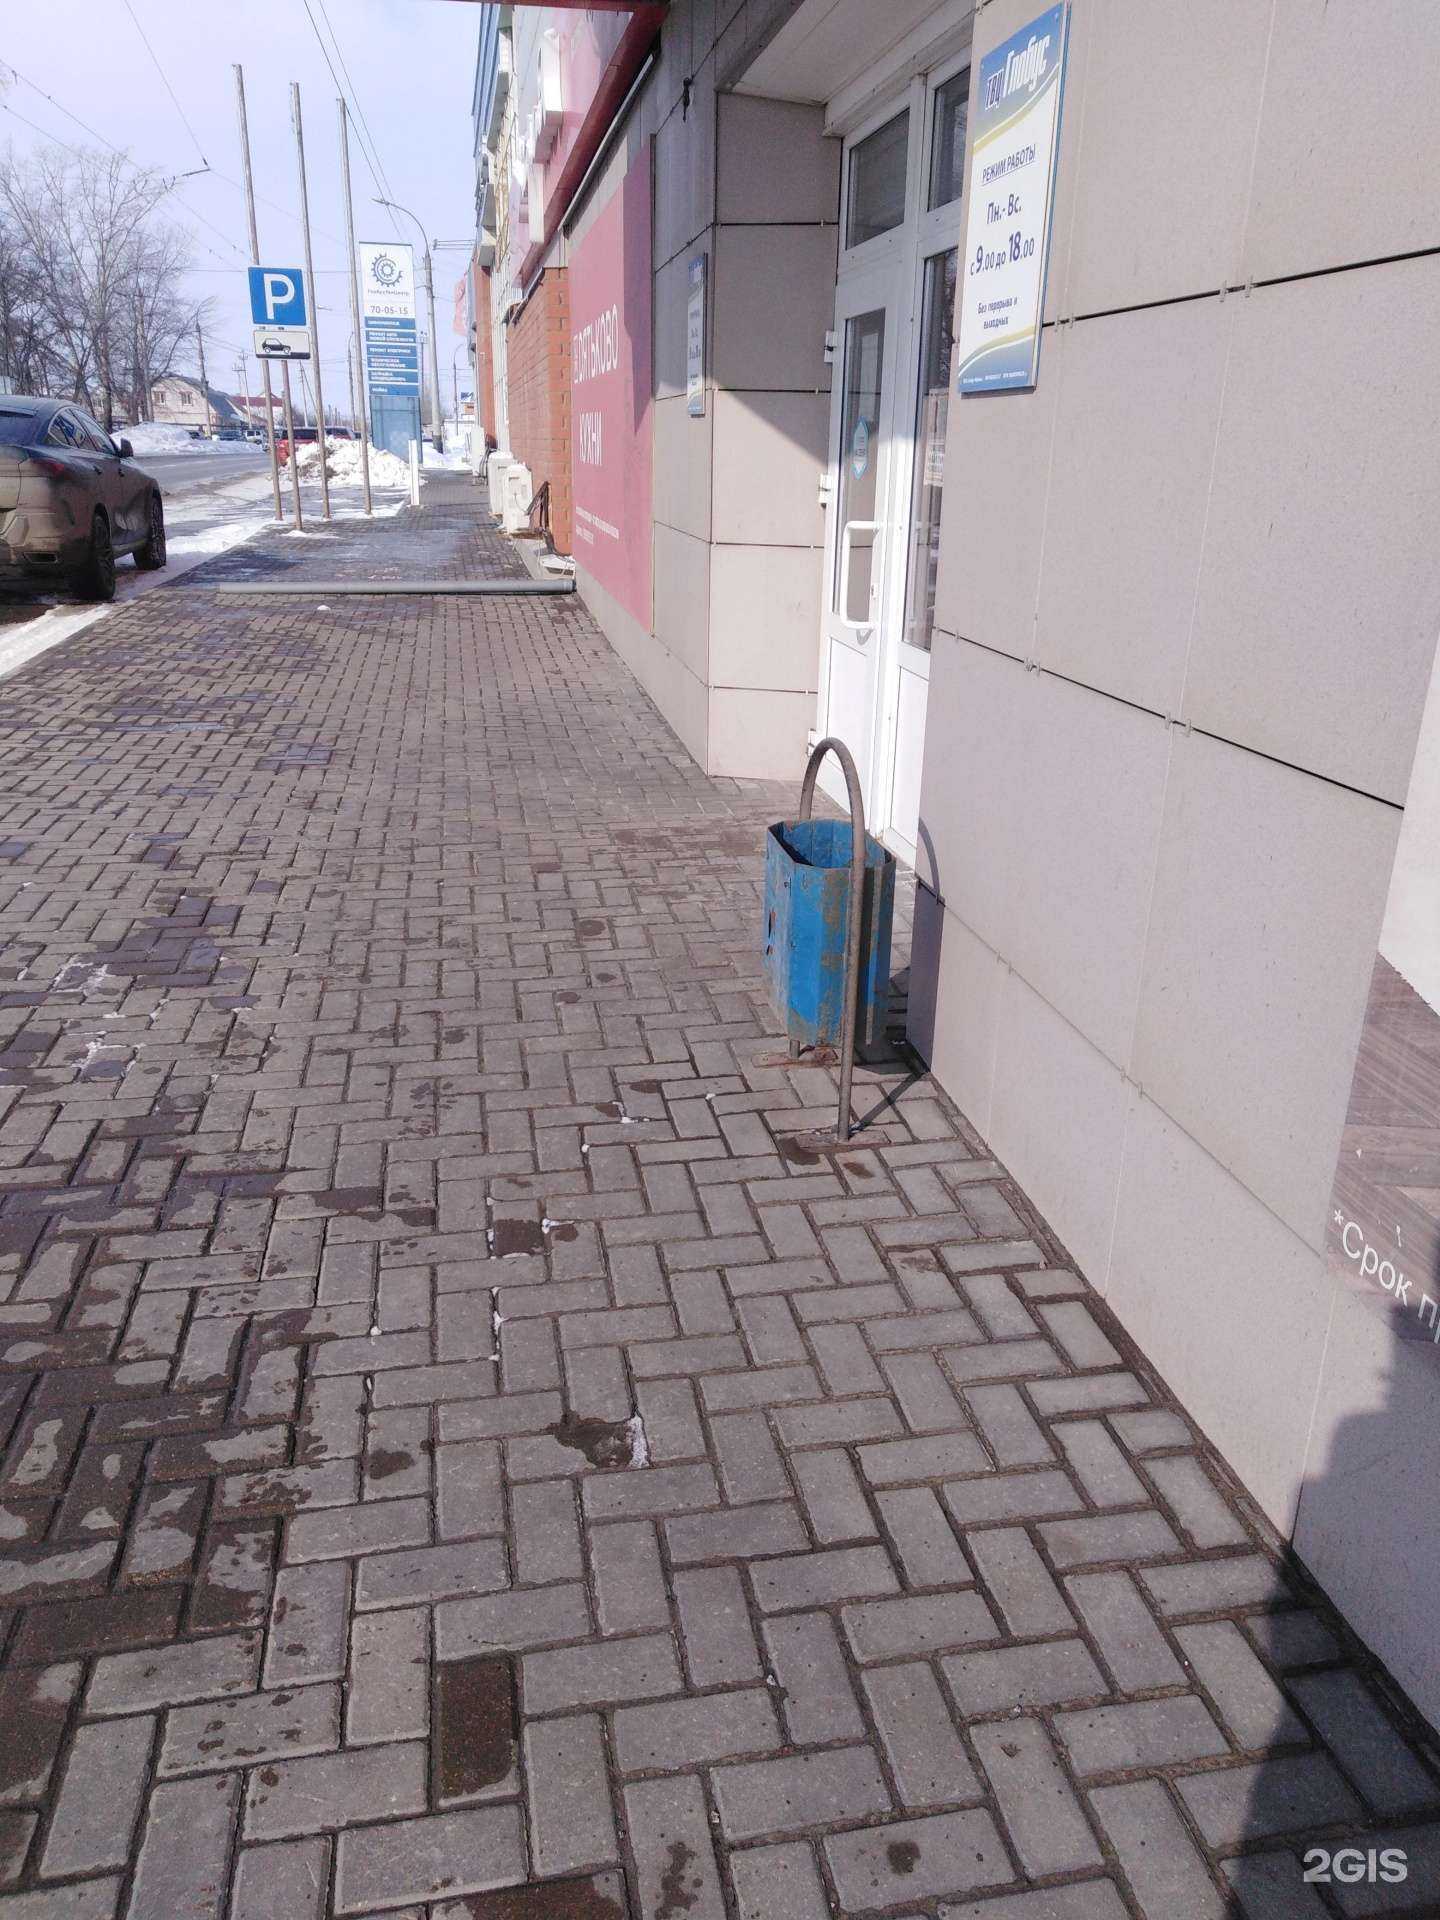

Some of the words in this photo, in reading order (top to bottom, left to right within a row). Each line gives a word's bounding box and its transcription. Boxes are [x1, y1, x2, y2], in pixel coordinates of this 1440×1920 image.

[1002, 34, 1050, 98] Глобус
[982, 158, 1007, 183] РЕЖИМ
[1007, 144, 1036, 173] РАБОТЫ
[976, 245, 995, 273] 9.00
[995, 250, 1006, 270] до
[1009, 231, 1035, 262] 18.00
[263, 272, 296, 320] P
[978, 302, 988, 314] Без
